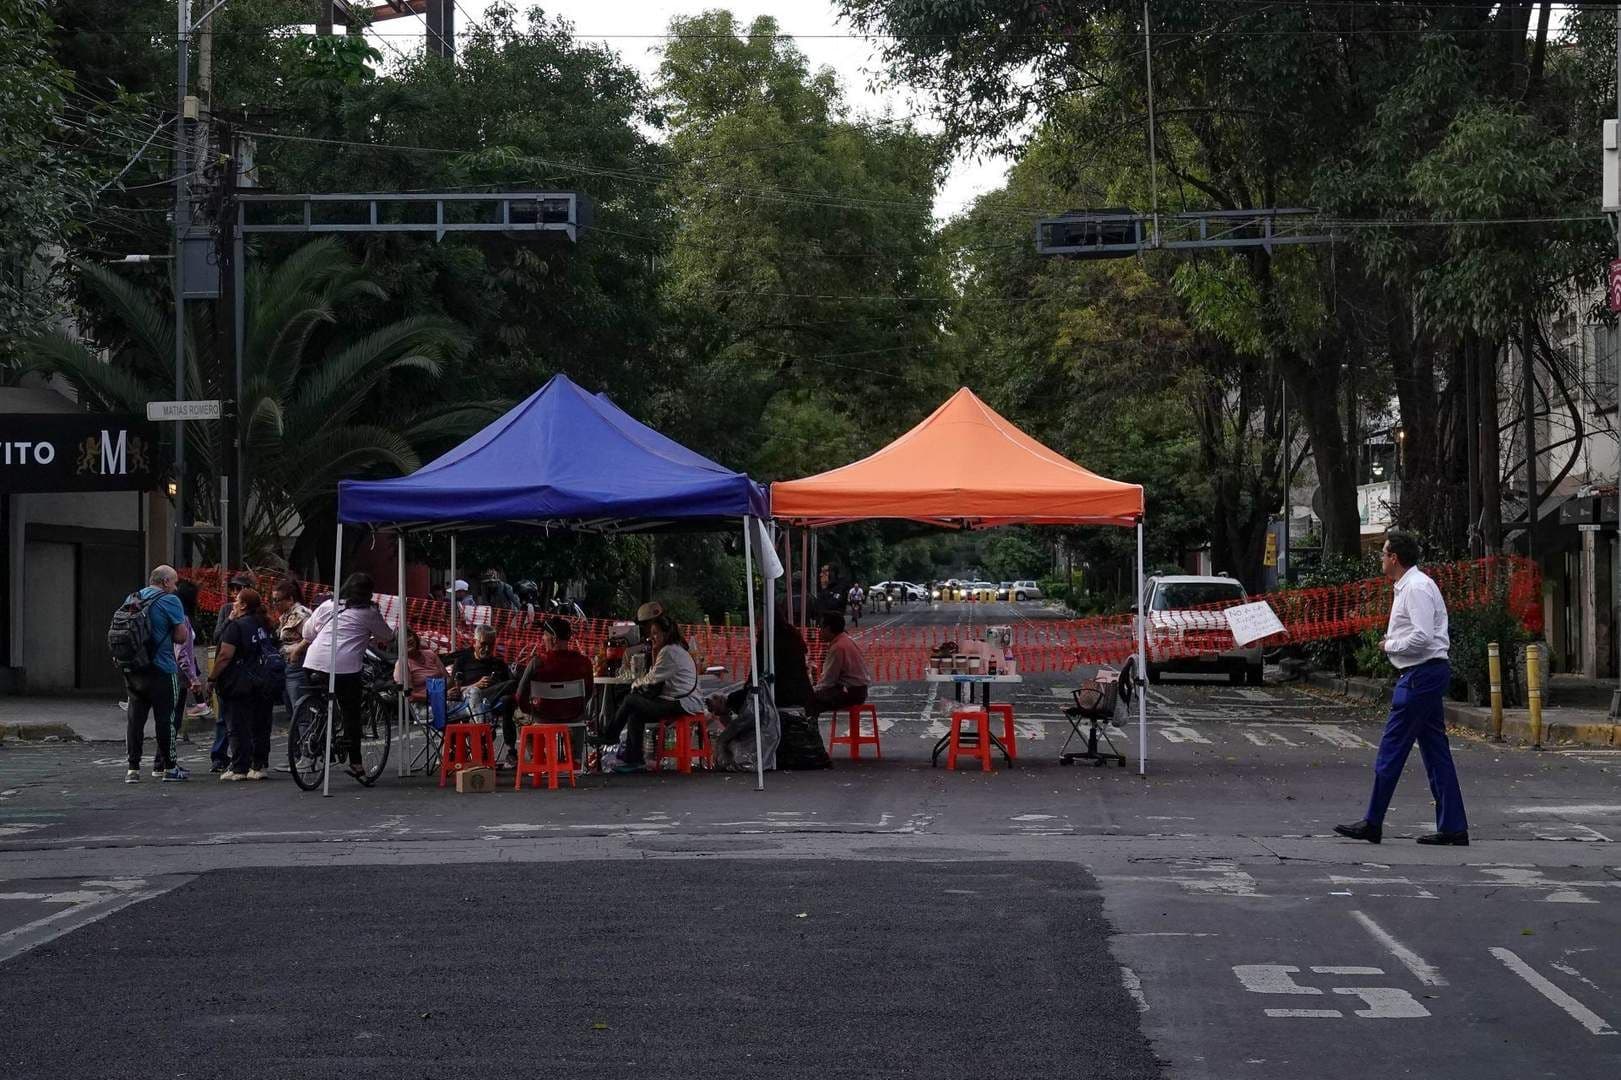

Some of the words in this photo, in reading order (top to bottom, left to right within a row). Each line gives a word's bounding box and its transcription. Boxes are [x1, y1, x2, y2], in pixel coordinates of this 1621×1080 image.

[163, 405, 188, 416] MATIAS
[189, 404, 218, 416] ROMERO
[0, 441, 55, 465] ITO
[100, 429, 128, 475] M
